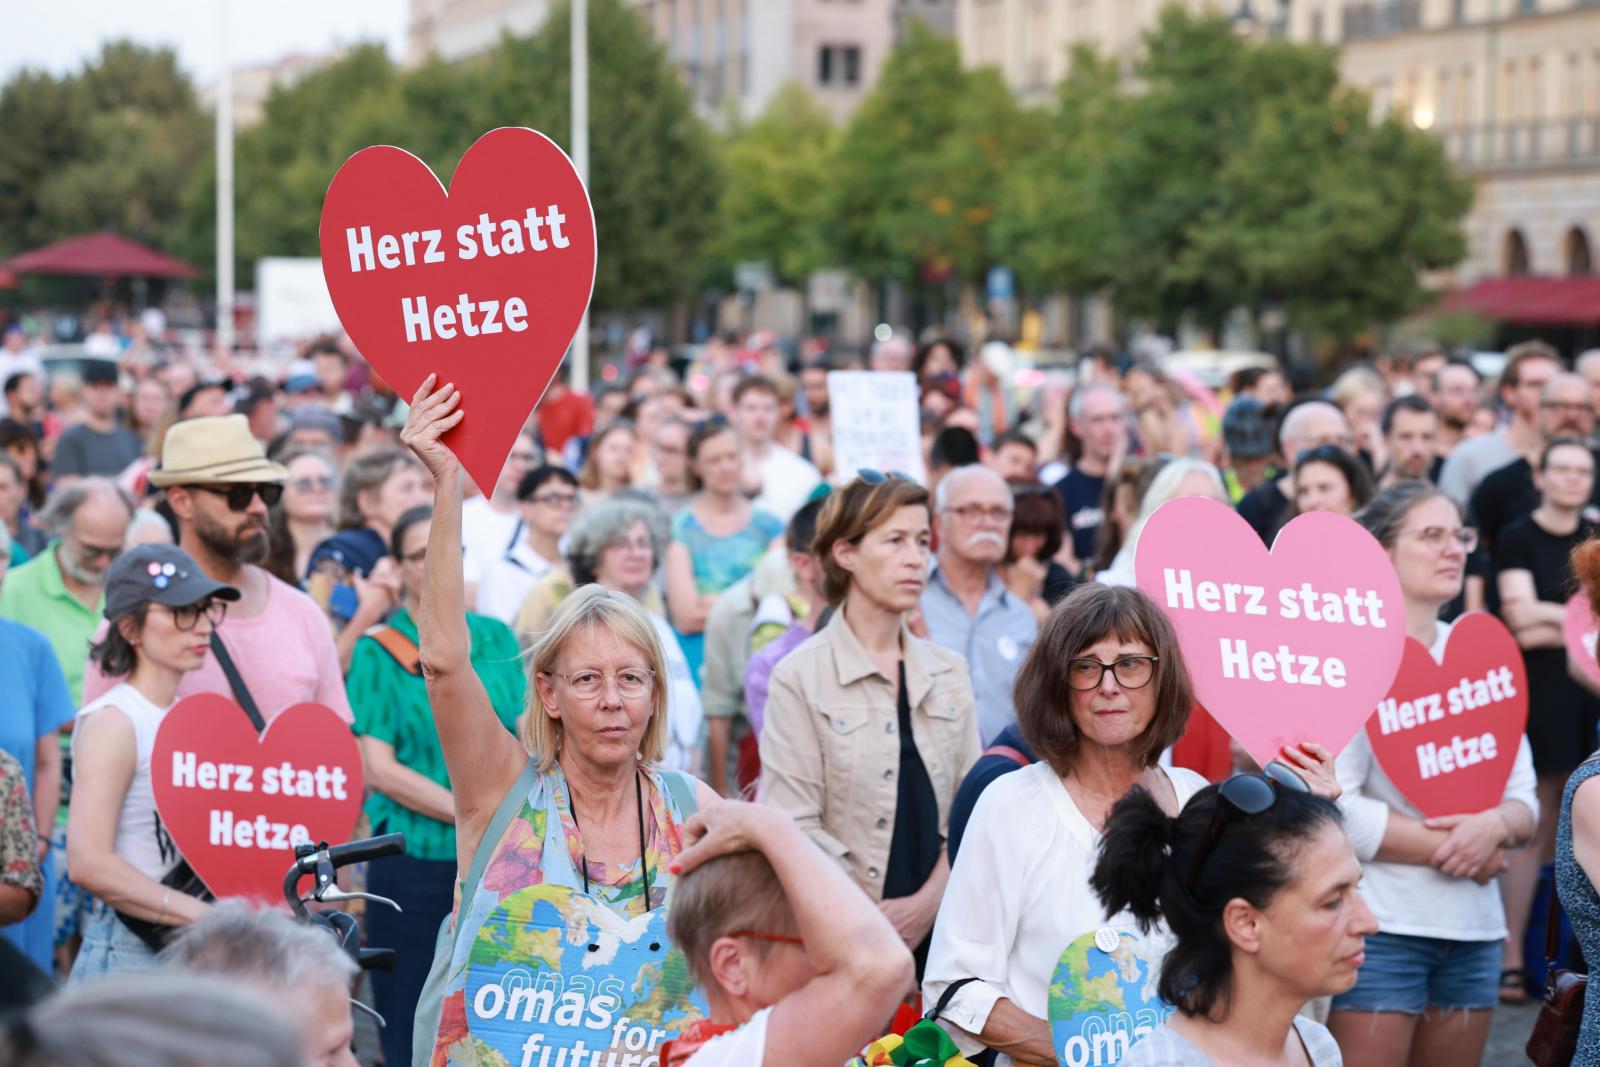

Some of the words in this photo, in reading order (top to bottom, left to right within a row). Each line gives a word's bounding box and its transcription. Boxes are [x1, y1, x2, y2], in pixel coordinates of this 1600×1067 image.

[346, 224, 445, 273] Herz
[456, 204, 570, 260] statt
[401, 294, 529, 343] Hetze
[1163, 568, 1267, 616] Herz
[1279, 582, 1387, 629] statt
[1220, 637, 1347, 689] Hetze
[1378, 692, 1445, 736] Herz
[1447, 665, 1517, 715] statt
[172, 750, 255, 792] Herz
[261, 761, 348, 801] statt
[1416, 732, 1498, 780] Hetze
[209, 809, 315, 850] Hetze
[474, 983, 616, 1030] omas
[501, 968, 625, 1018] opas
[610, 1016, 667, 1053] for
